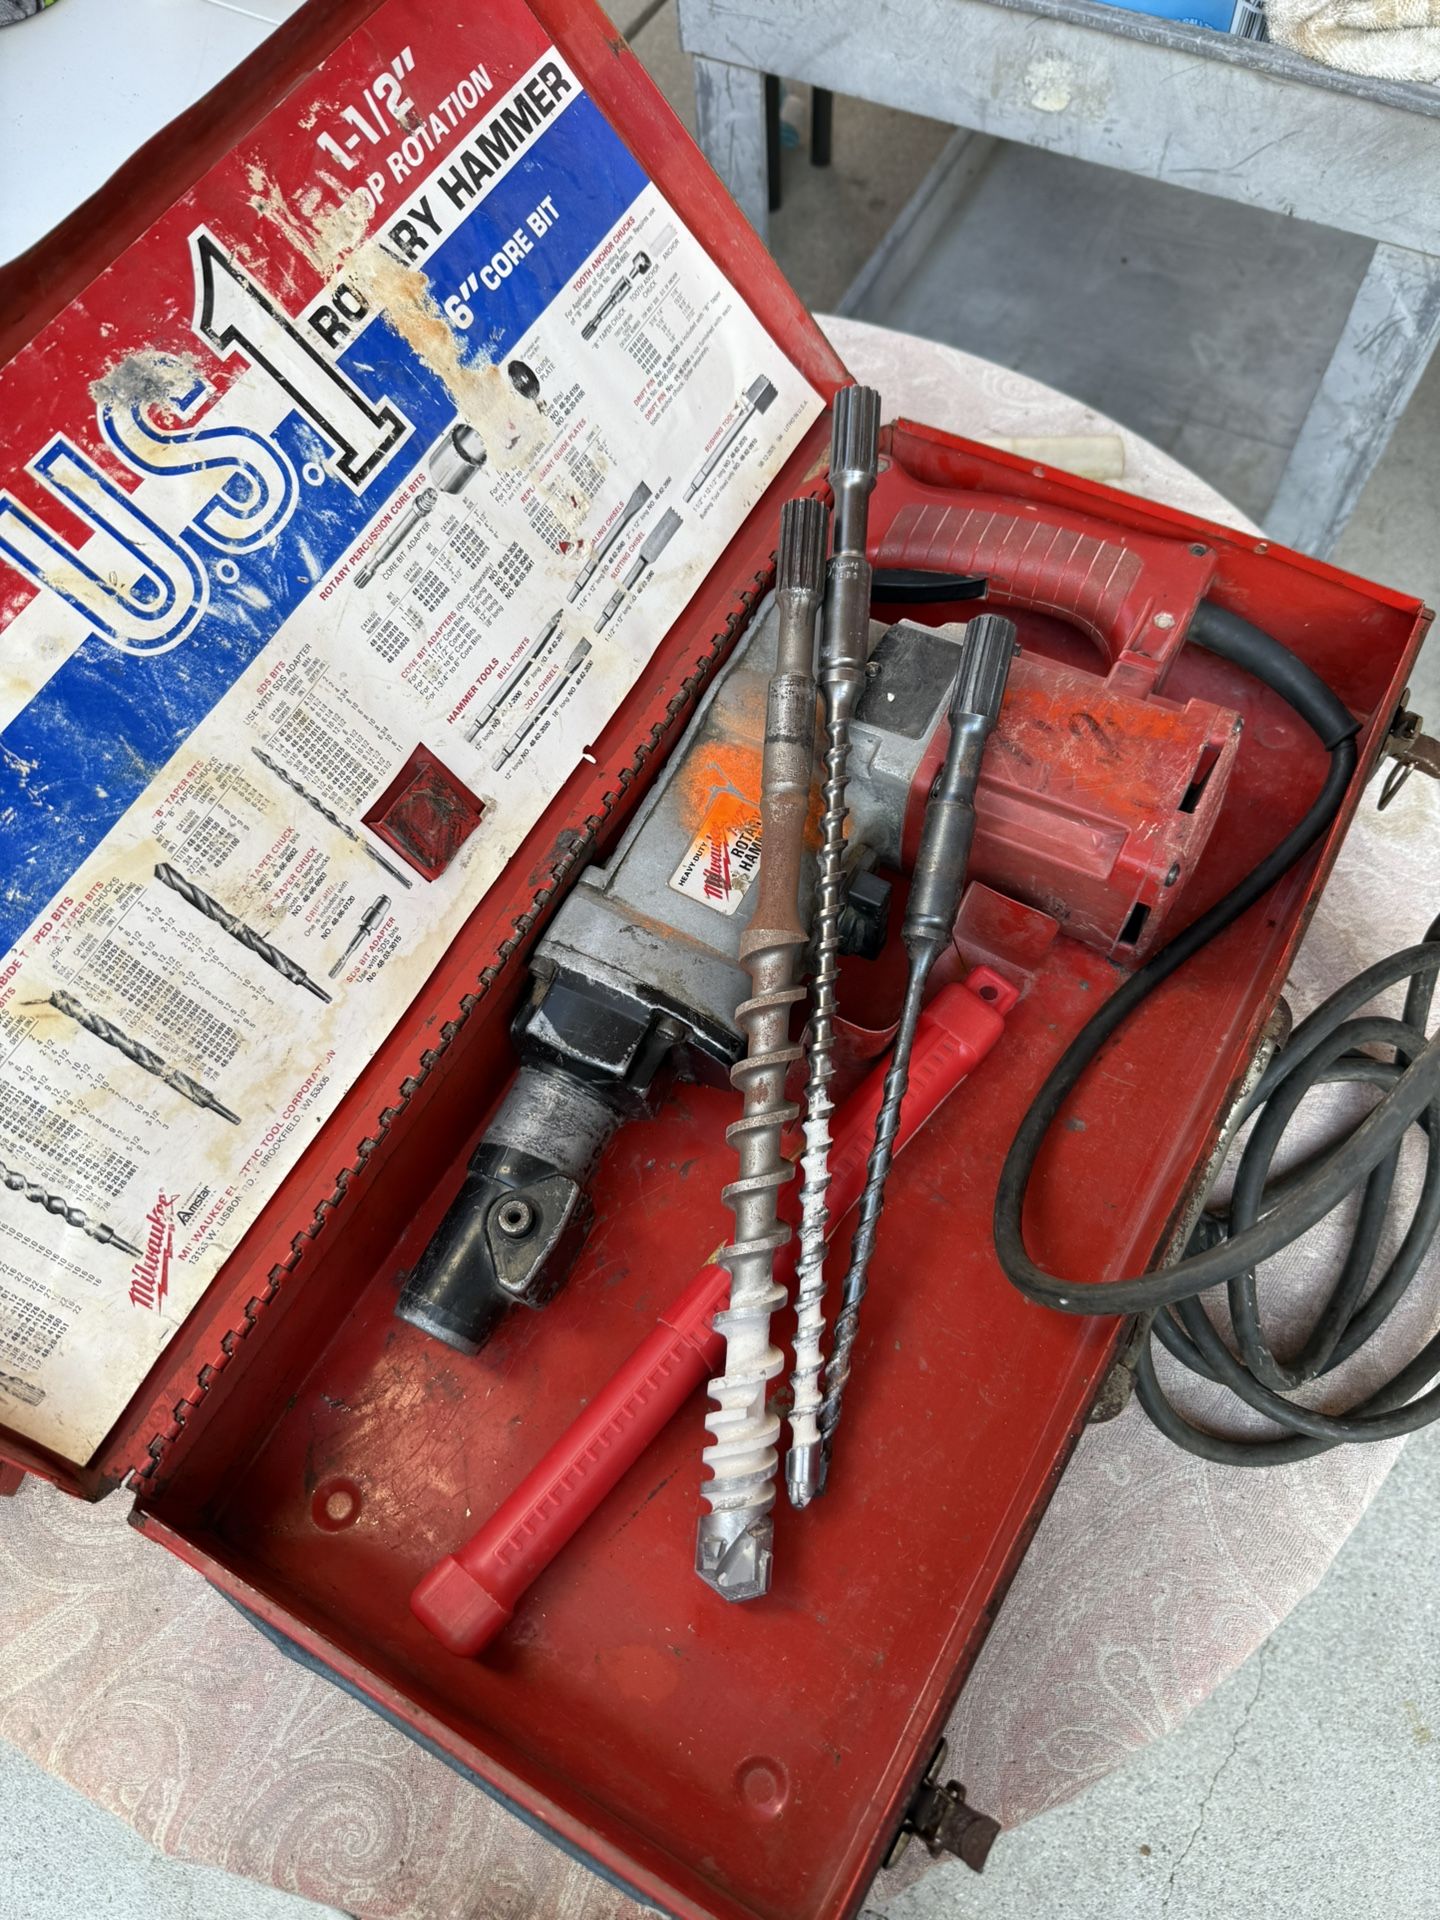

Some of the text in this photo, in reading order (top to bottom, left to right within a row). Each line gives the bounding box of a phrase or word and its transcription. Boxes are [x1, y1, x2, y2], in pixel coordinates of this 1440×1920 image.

[381, 61, 497, 186] ROTATION
[305, 57, 574, 351] RORY HAMMER
[476, 226, 536, 294] CORE
[523, 193, 564, 240] BIT
[572, 215, 636, 292] TOOTH ANCHOR CHUCKS
[661, 237, 680, 260] ANCHOR
[629, 262, 660, 302] TOOTH ANCHOR
[641, 278, 657, 298] CHUCK
[598, 323, 613, 341] TAPER
[610, 306, 626, 326] CHUCK
[534, 356, 550, 375] GUIDE
[539, 361, 556, 381] PLATE
[549, 408, 561, 422] NO.
[553, 439, 570, 461] GUIDE
[567, 417, 587, 442] PLATES
[704, 426, 724, 453] BUSHING
[318, 471, 427, 601] ROTARY PERCUSSION CORE BITS
[604, 499, 625, 527] CHISELS
[381, 520, 431, 581] CORE BIT ADAPTER
[609, 530, 646, 580] SLOTTING CHISEL
[400, 657, 419, 680] CORE
[416, 645, 429, 660] BIT
[426, 609, 457, 648] ADAPTERS
[407, 672, 419, 685] For
[427, 638, 446, 660] 1-1/2"
[442, 625, 456, 642] Core
[452, 613, 465, 628] Bits
[474, 585, 488, 601] long
[488, 567, 500, 581] NO.
[419, 683, 431, 697] For
[443, 658, 451, 668] to
[447, 650, 457, 661] 6"
[453, 637, 468, 654] Core
[464, 625, 477, 641] Bits
[485, 597, 499, 614] long
[499, 580, 511, 594] NO.
[242, 708, 259, 726] USE
[255, 688, 275, 711] WITH
[271, 673, 287, 691] SDS
[284, 642, 312, 675] ADAPTER
[255, 659, 286, 695] SDS BITS
[496, 636, 530, 680] BULL POINTS
[537, 662, 560, 692] CHISELS
[446, 656, 500, 725] HAMMER TOOLS
[151, 758, 205, 821] "B" TAPER BITS
[151, 755, 219, 836] USE "B" TAPER CHUCKS
[249, 824, 295, 881] TAPER CHUCK
[256, 831, 300, 887] with "A" taper bits
[274, 871, 298, 900] TAPER
[294, 845, 318, 874] CHUCK
[280, 851, 323, 906] with "B" taper bits
[297, 874, 316, 896] anchor
[312, 854, 331, 876] chucks
[678, 841, 707, 887] HEAVY-DUTY
[59, 929, 76, 946] "A"
[91, 875, 120, 907] CHUCKS
[260, 877, 275, 894] NO.
[291, 901, 304, 917] NO.
[303, 878, 349, 937] One is included with
[304, 899, 324, 923] DRIFT
[319, 895, 345, 930] each chuck
[45, 928, 65, 948] "A"
[84, 879, 105, 902] BITS
[320, 894, 356, 940] NO. 48-86-0120
[0, 895, 75, 990] BIDE TPED BITS
[345, 915, 396, 983] SDS BIT ADAPTER
[356, 924, 399, 983] Use with SDS bits
[365, 933, 402, 983] No. 48-03-3015
[177, 1196, 228, 1262] MIWAUKEE
[260, 1119, 284, 1149] TOOL
[205, 1226, 219, 1241] W.
[258, 1110, 304, 1169] BROOKFIELD,
[300, 1097, 313, 1111] WI
[173, 1180, 213, 1226] Amstar
[128, 1190, 172, 1310] Milwaukee
